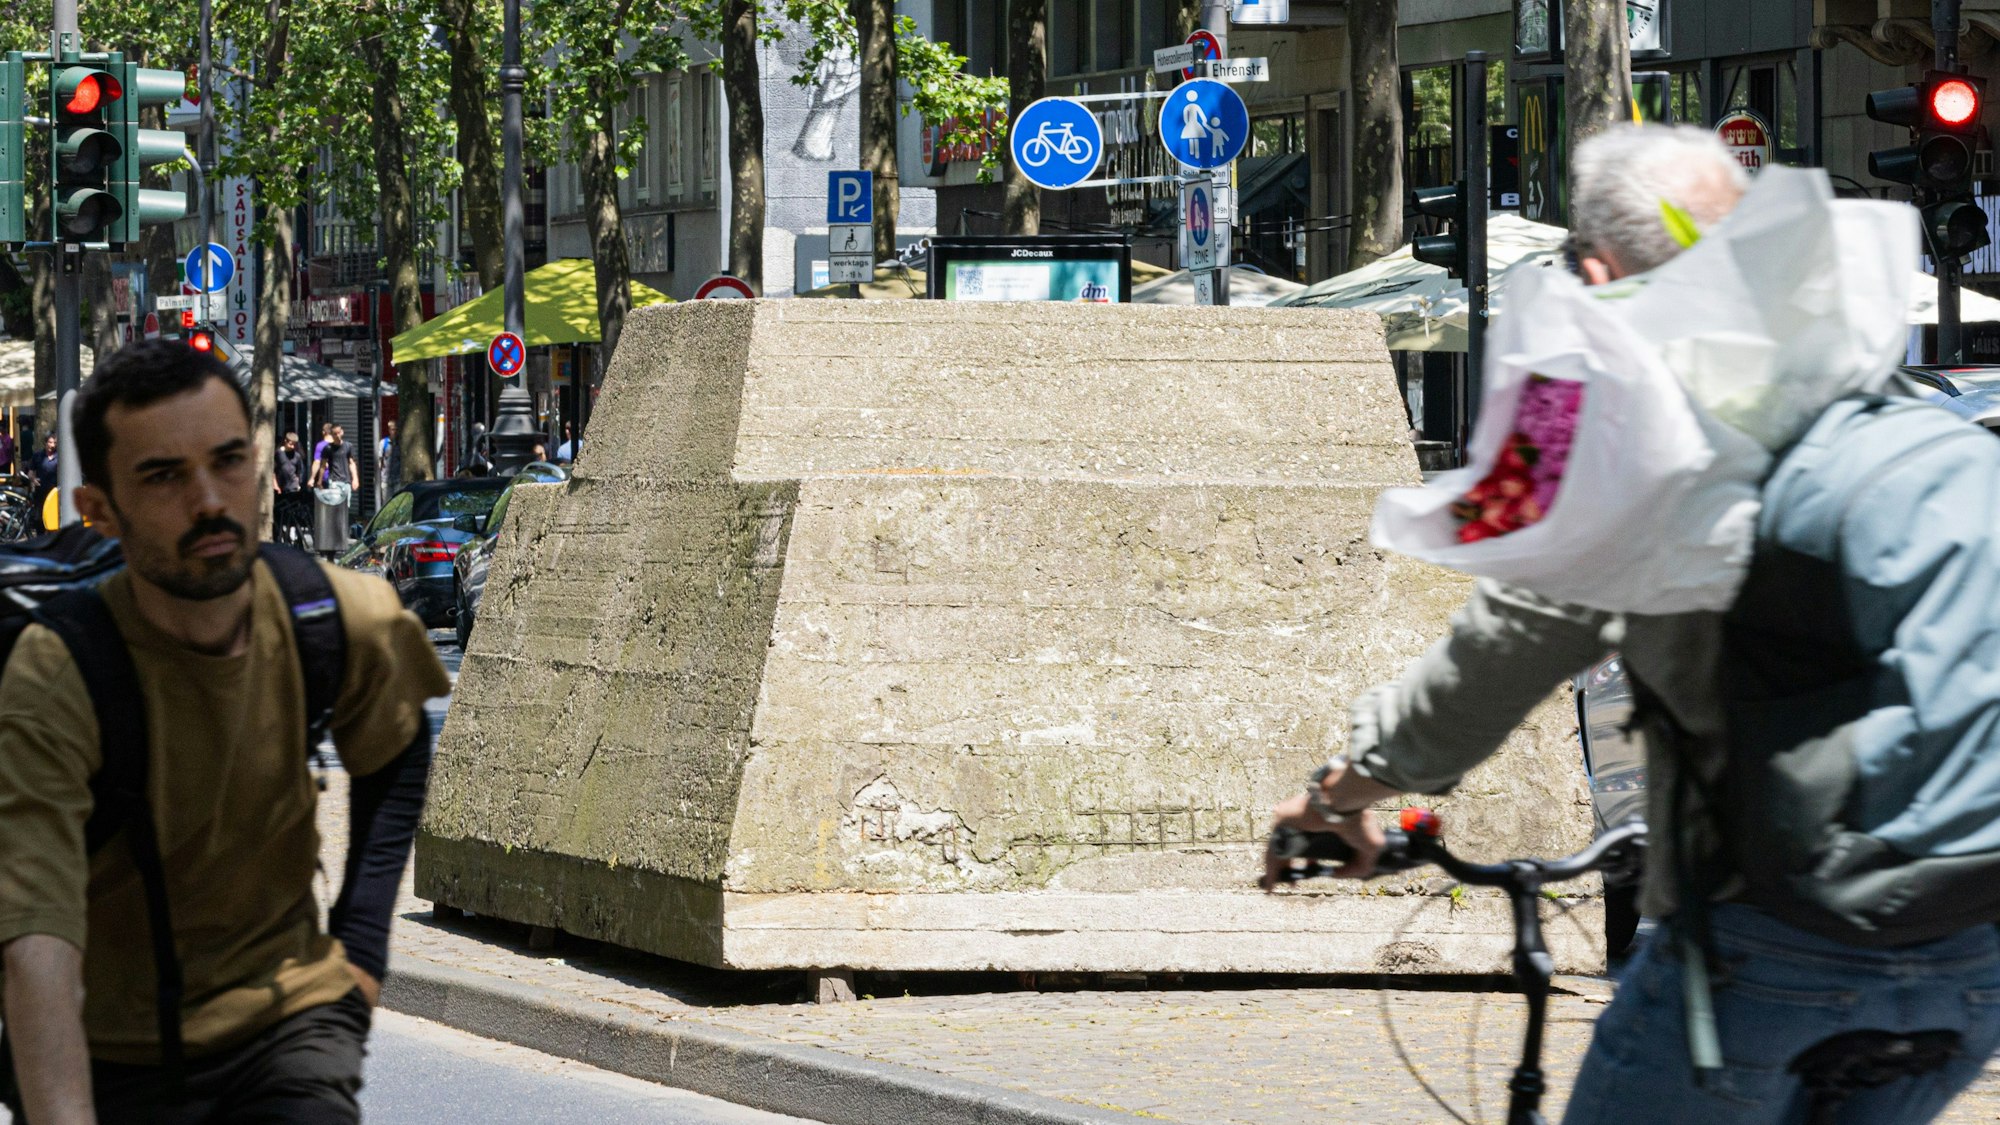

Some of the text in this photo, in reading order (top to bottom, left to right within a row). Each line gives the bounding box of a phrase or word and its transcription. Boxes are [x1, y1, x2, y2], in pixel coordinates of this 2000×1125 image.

[1212, 62, 1264, 77] Ehrenstr.
[838, 177, 861, 217] P
[1011, 249, 1054, 258] JCDecaux
[1195, 249, 1209, 265] ZONE
[833, 260, 869, 268] werktags
[1081, 283, 1106, 299] dm
